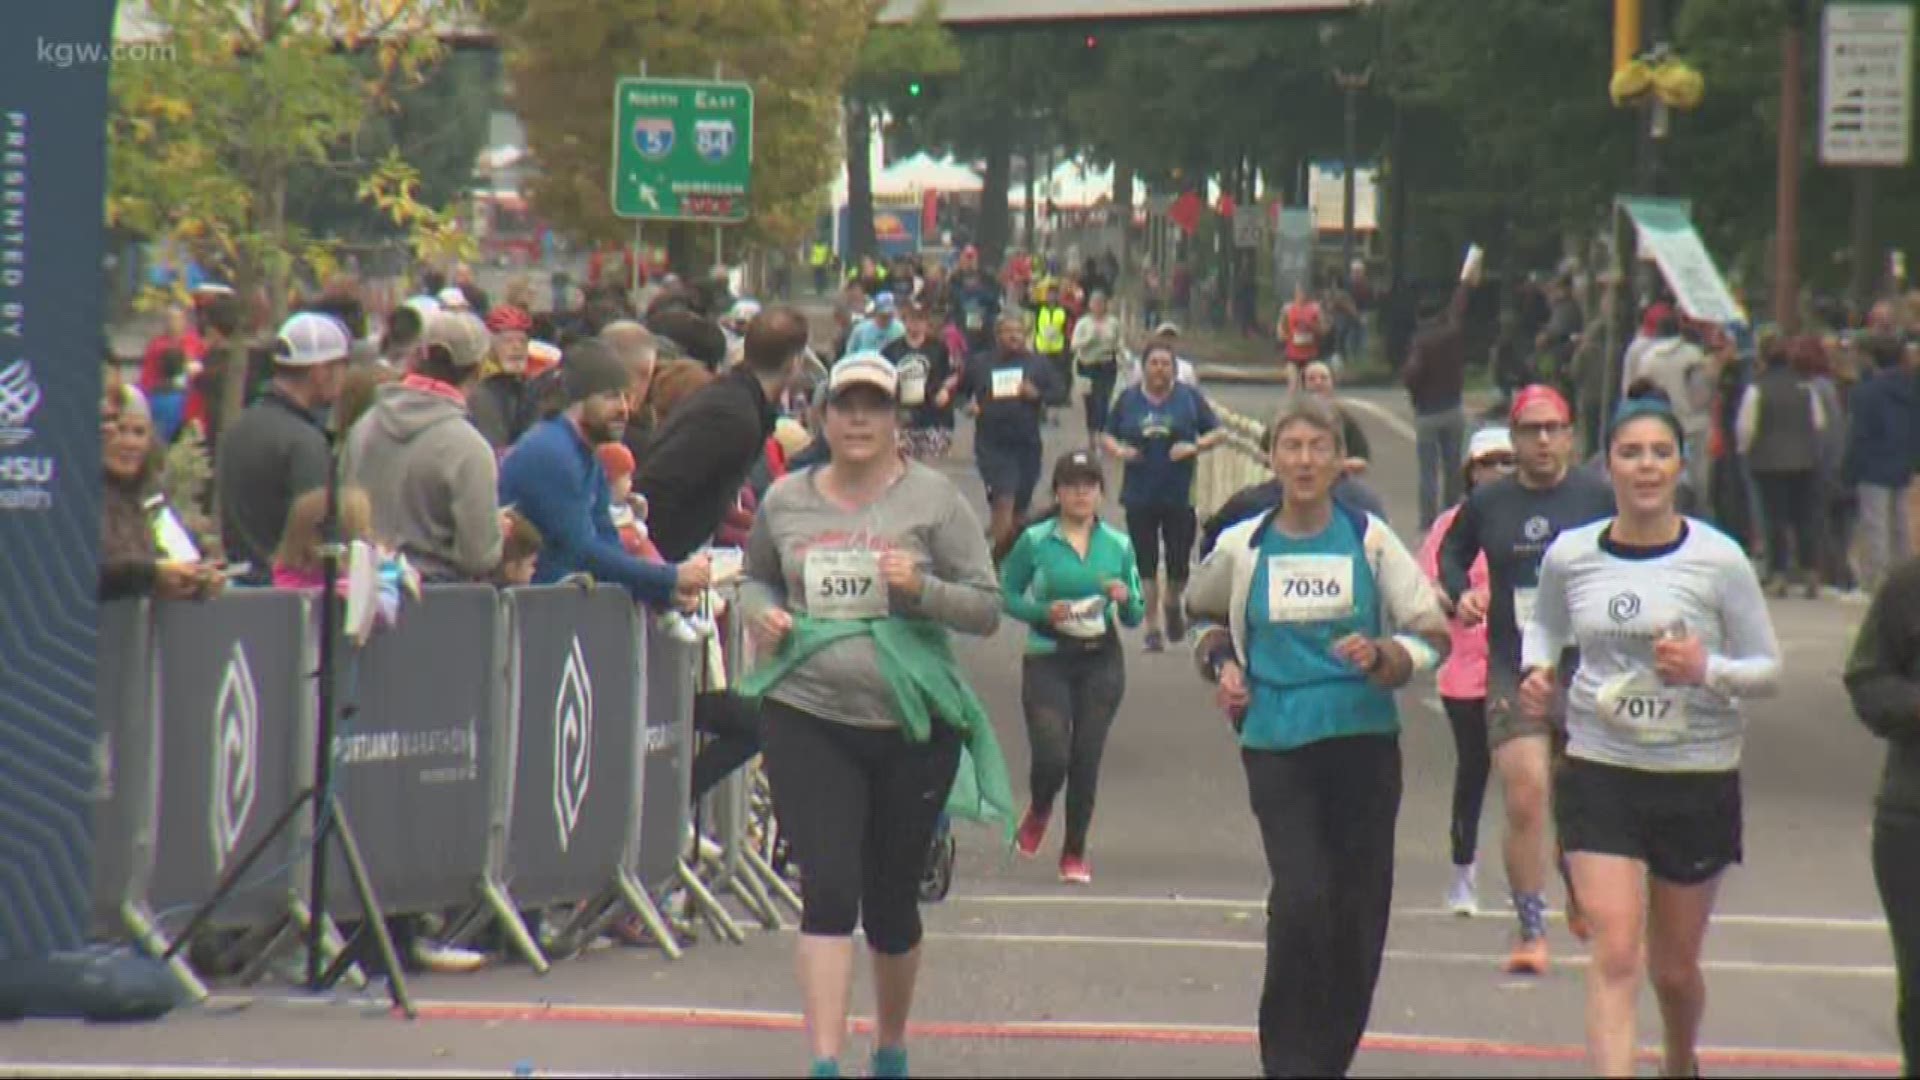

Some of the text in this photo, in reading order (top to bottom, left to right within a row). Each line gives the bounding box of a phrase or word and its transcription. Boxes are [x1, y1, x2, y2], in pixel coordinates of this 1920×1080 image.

[647, 131, 729, 153] 5 84
[3, 111, 26, 336] PRESENTED BY
[820, 576, 872, 597] 5317
[1282, 577, 1341, 598] 7036
[1613, 696, 1672, 720] 7017
